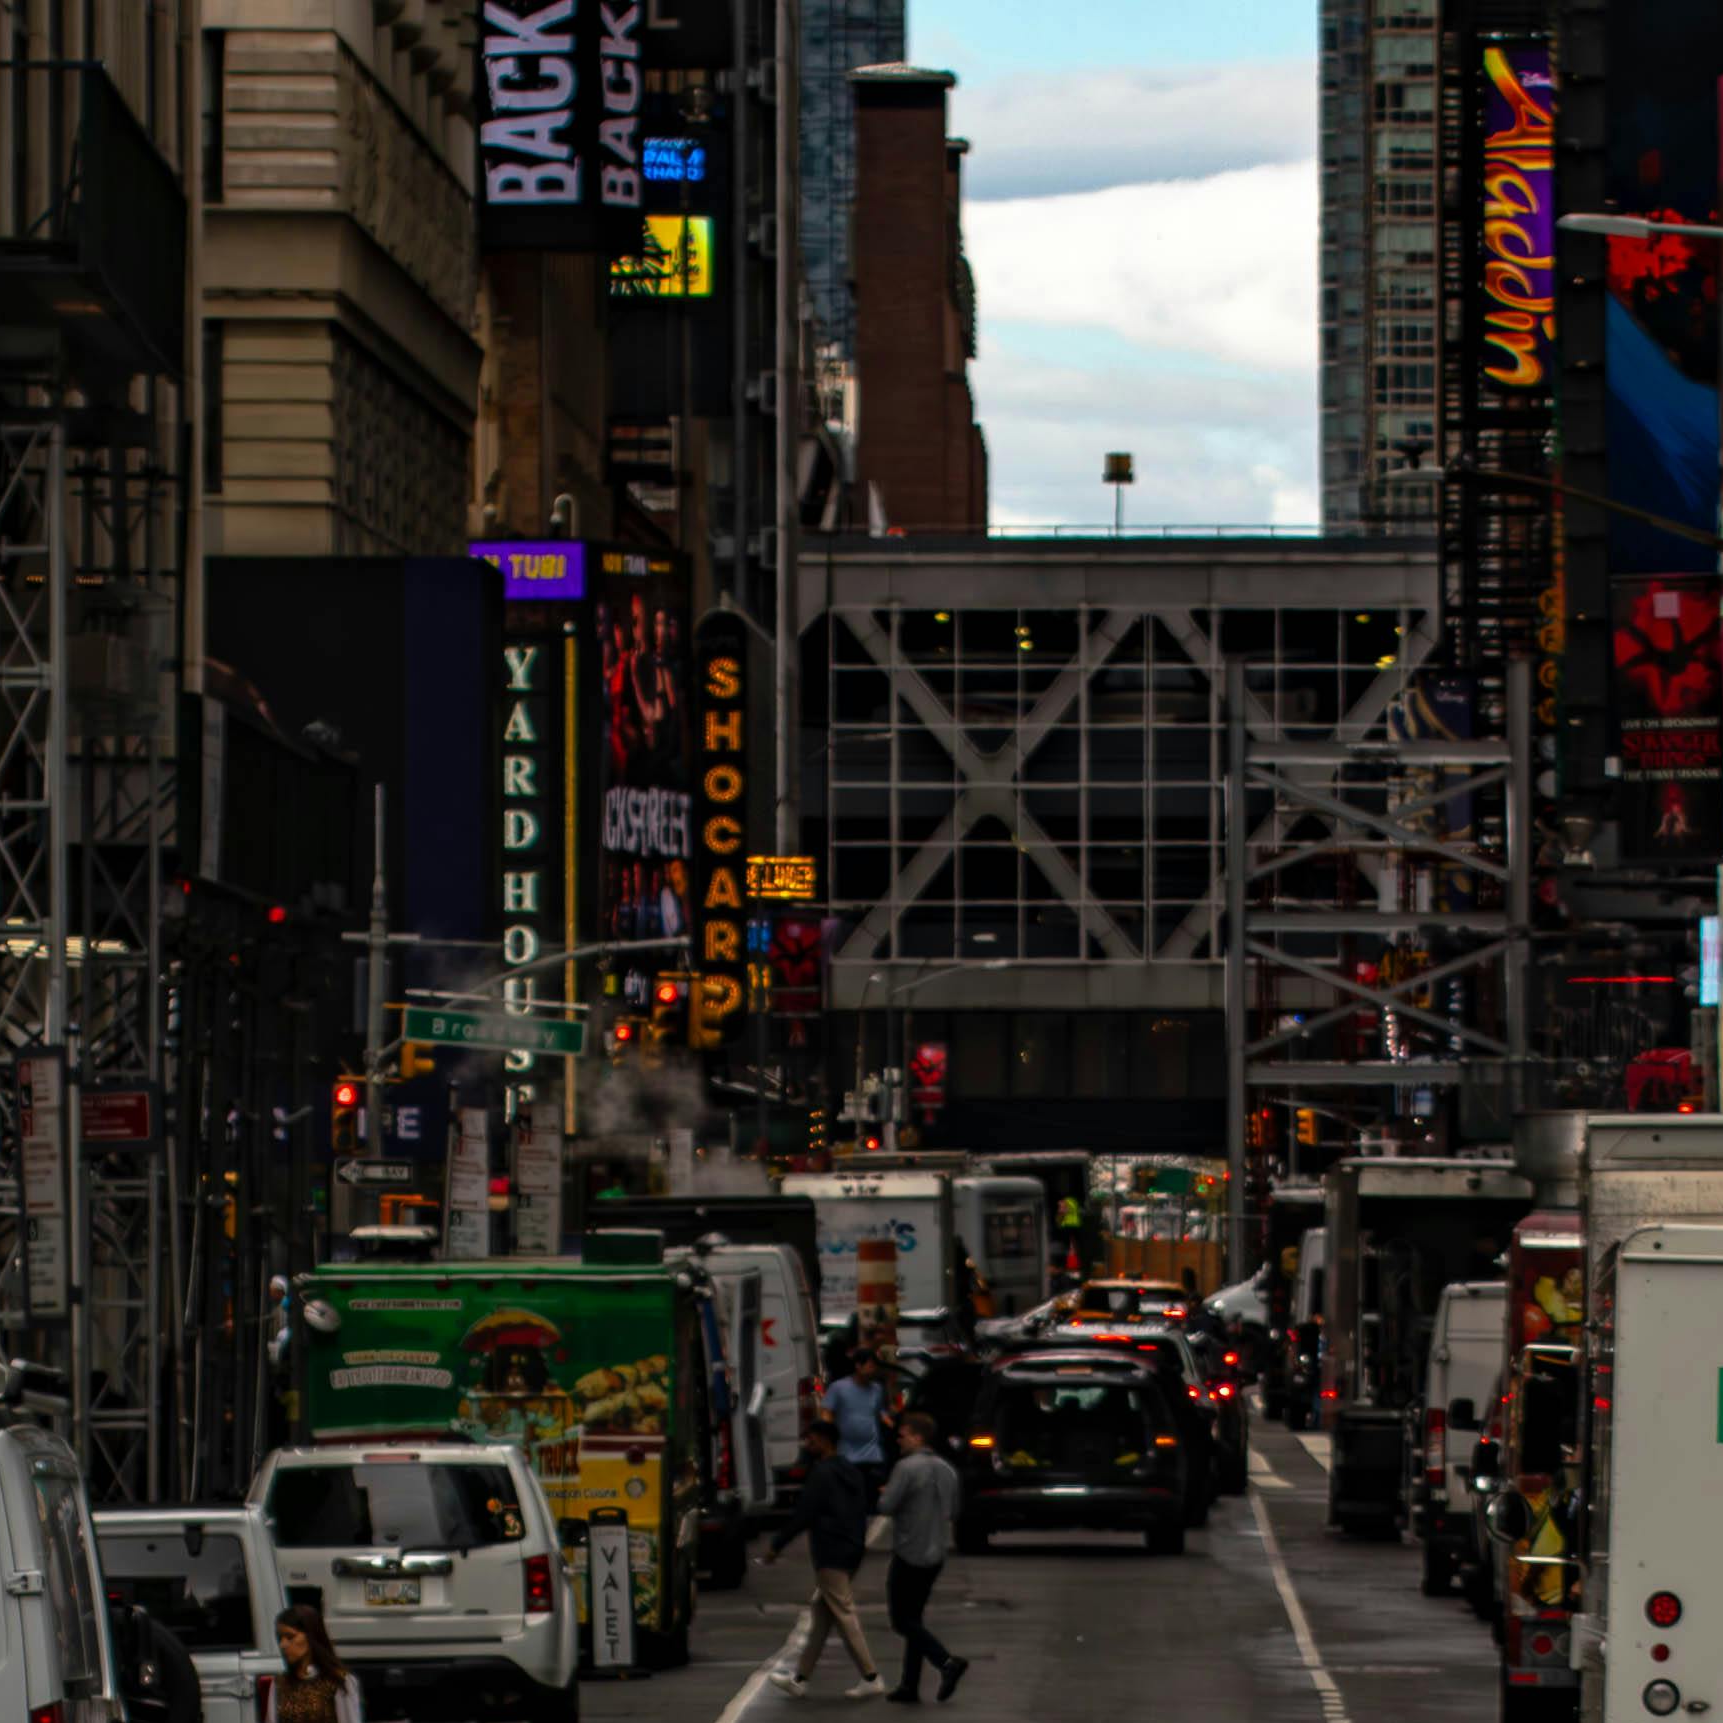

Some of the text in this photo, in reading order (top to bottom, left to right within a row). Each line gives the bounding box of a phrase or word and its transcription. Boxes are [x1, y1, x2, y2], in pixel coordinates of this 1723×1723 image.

[1484, 47, 1555, 386] Aladdin
[503, 645, 540, 851] YARD
[601, 1546, 620, 1660] VALET
